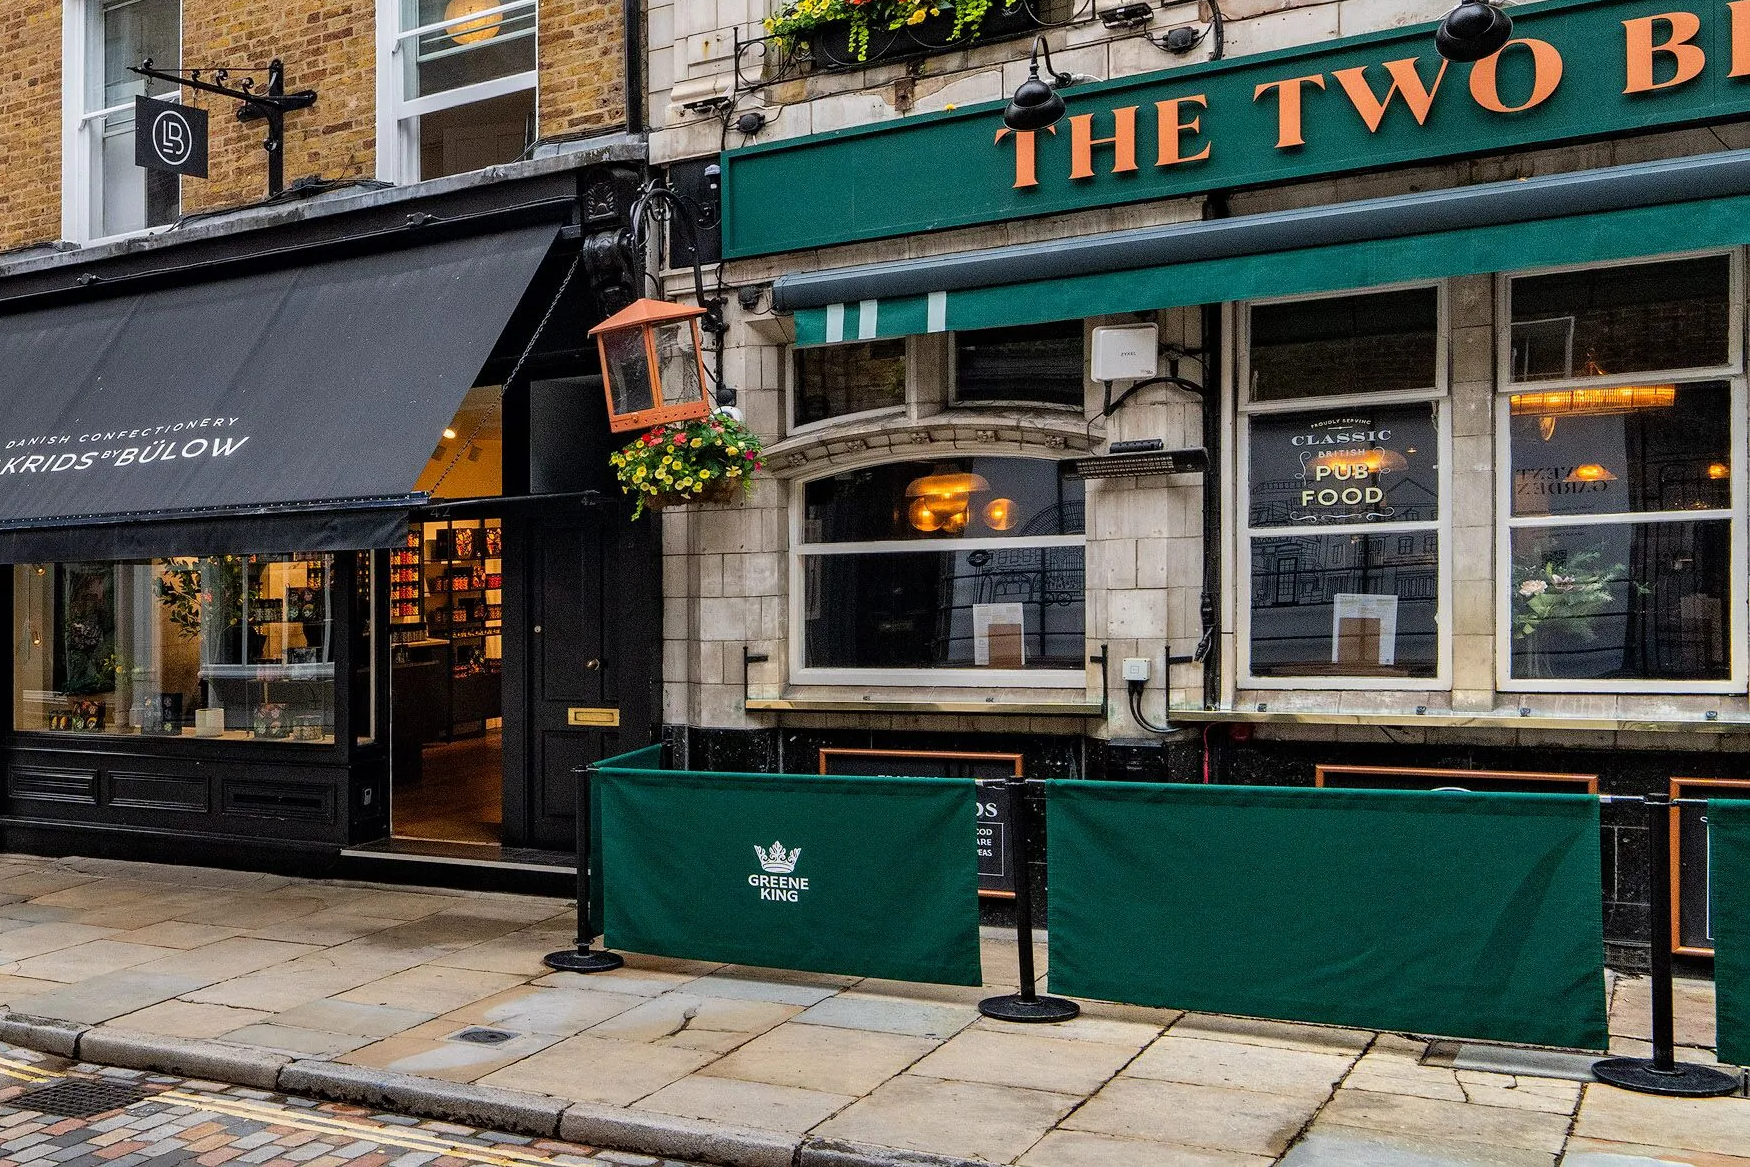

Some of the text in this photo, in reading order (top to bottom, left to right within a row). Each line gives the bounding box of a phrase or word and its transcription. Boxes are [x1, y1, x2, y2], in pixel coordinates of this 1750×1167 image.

[994, 94, 1212, 189] THE
[1253, 38, 1563, 148] TWO
[1311, 418, 1340, 429] PROUDLY
[5, 417, 240, 449] DANISH CONFECTIONERY
[1291, 430, 1392, 446] CLASSIC
[100, 449, 122, 459] BY
[114, 436, 250, 467] BÜLOW
[1318, 448, 1365, 458] BRITISH
[1316, 463, 1368, 481] PUB
[1302, 487, 1383, 506] FOOD
[748, 874, 809, 890] GREENE
[760, 888, 798, 902] KING
